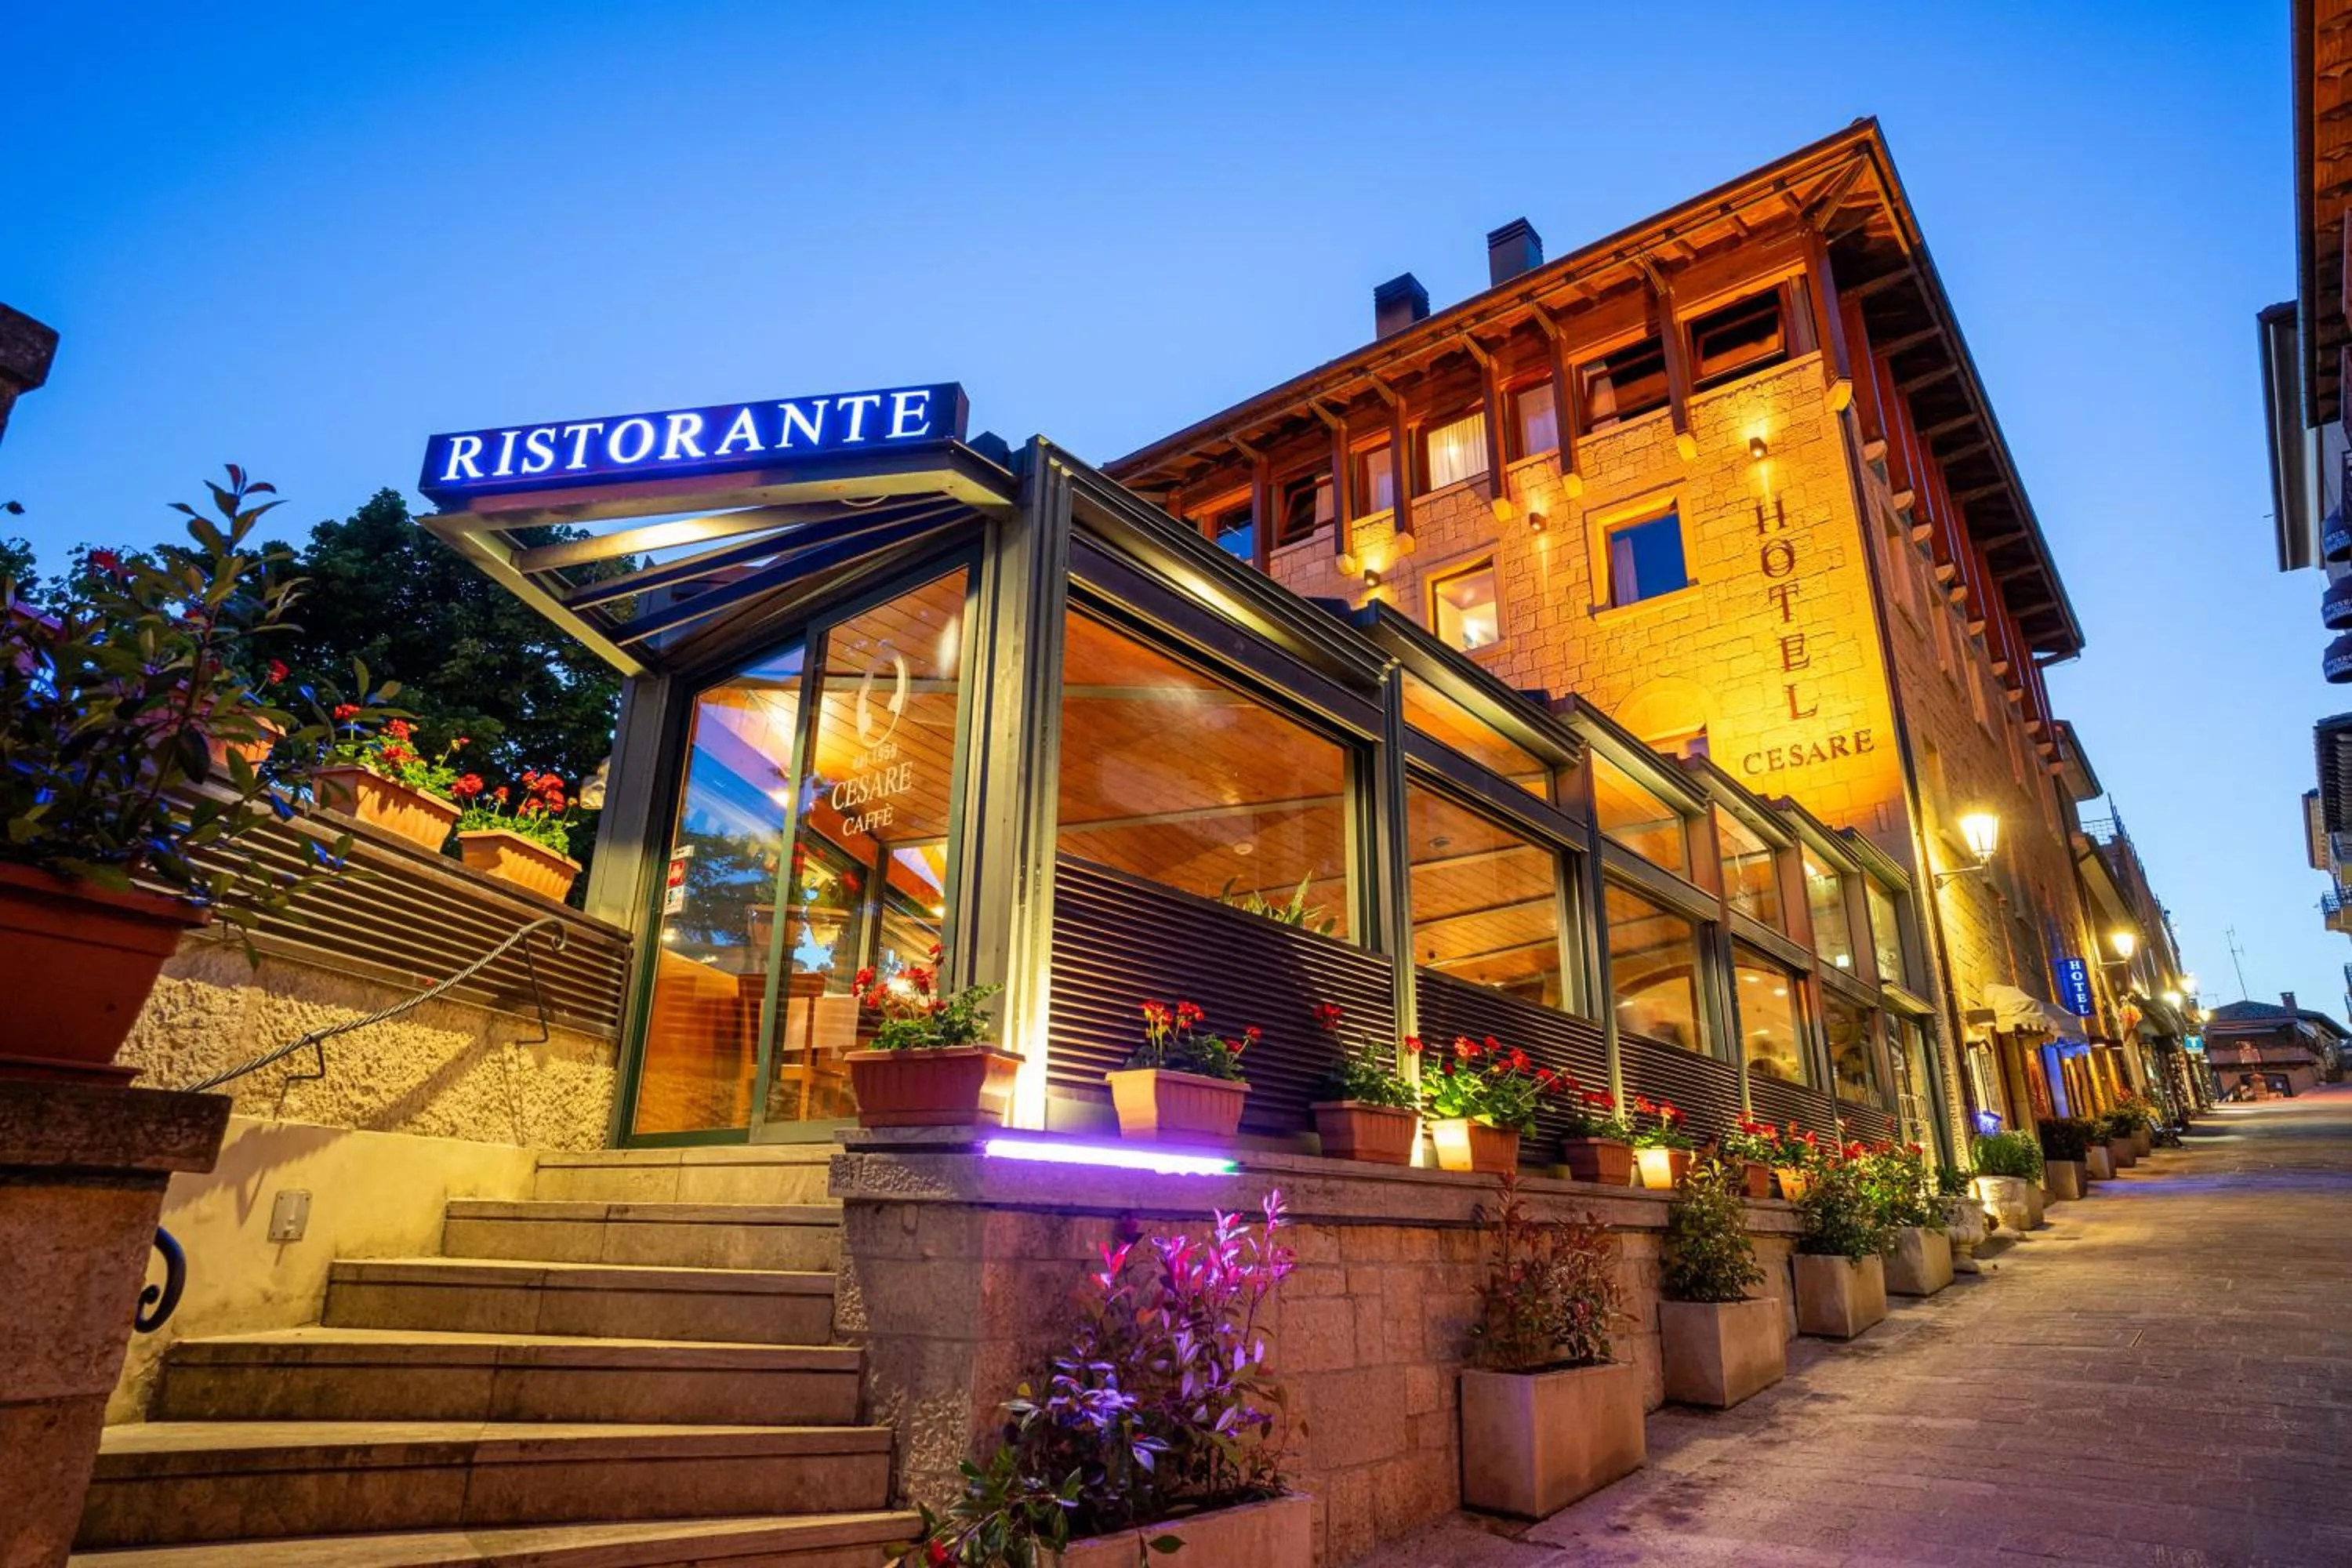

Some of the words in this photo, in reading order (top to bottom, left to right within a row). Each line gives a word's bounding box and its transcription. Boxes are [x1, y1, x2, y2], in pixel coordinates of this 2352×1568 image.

[441, 390, 931, 481] RISTORANTE
[1755, 496, 1819, 721] HOTEL
[1743, 728, 1875, 776] CESARE
[831, 761, 913, 811] CESARE
[842, 803, 894, 837] CAFFÈ
[2069, 960, 2089, 1014] HOTEL
